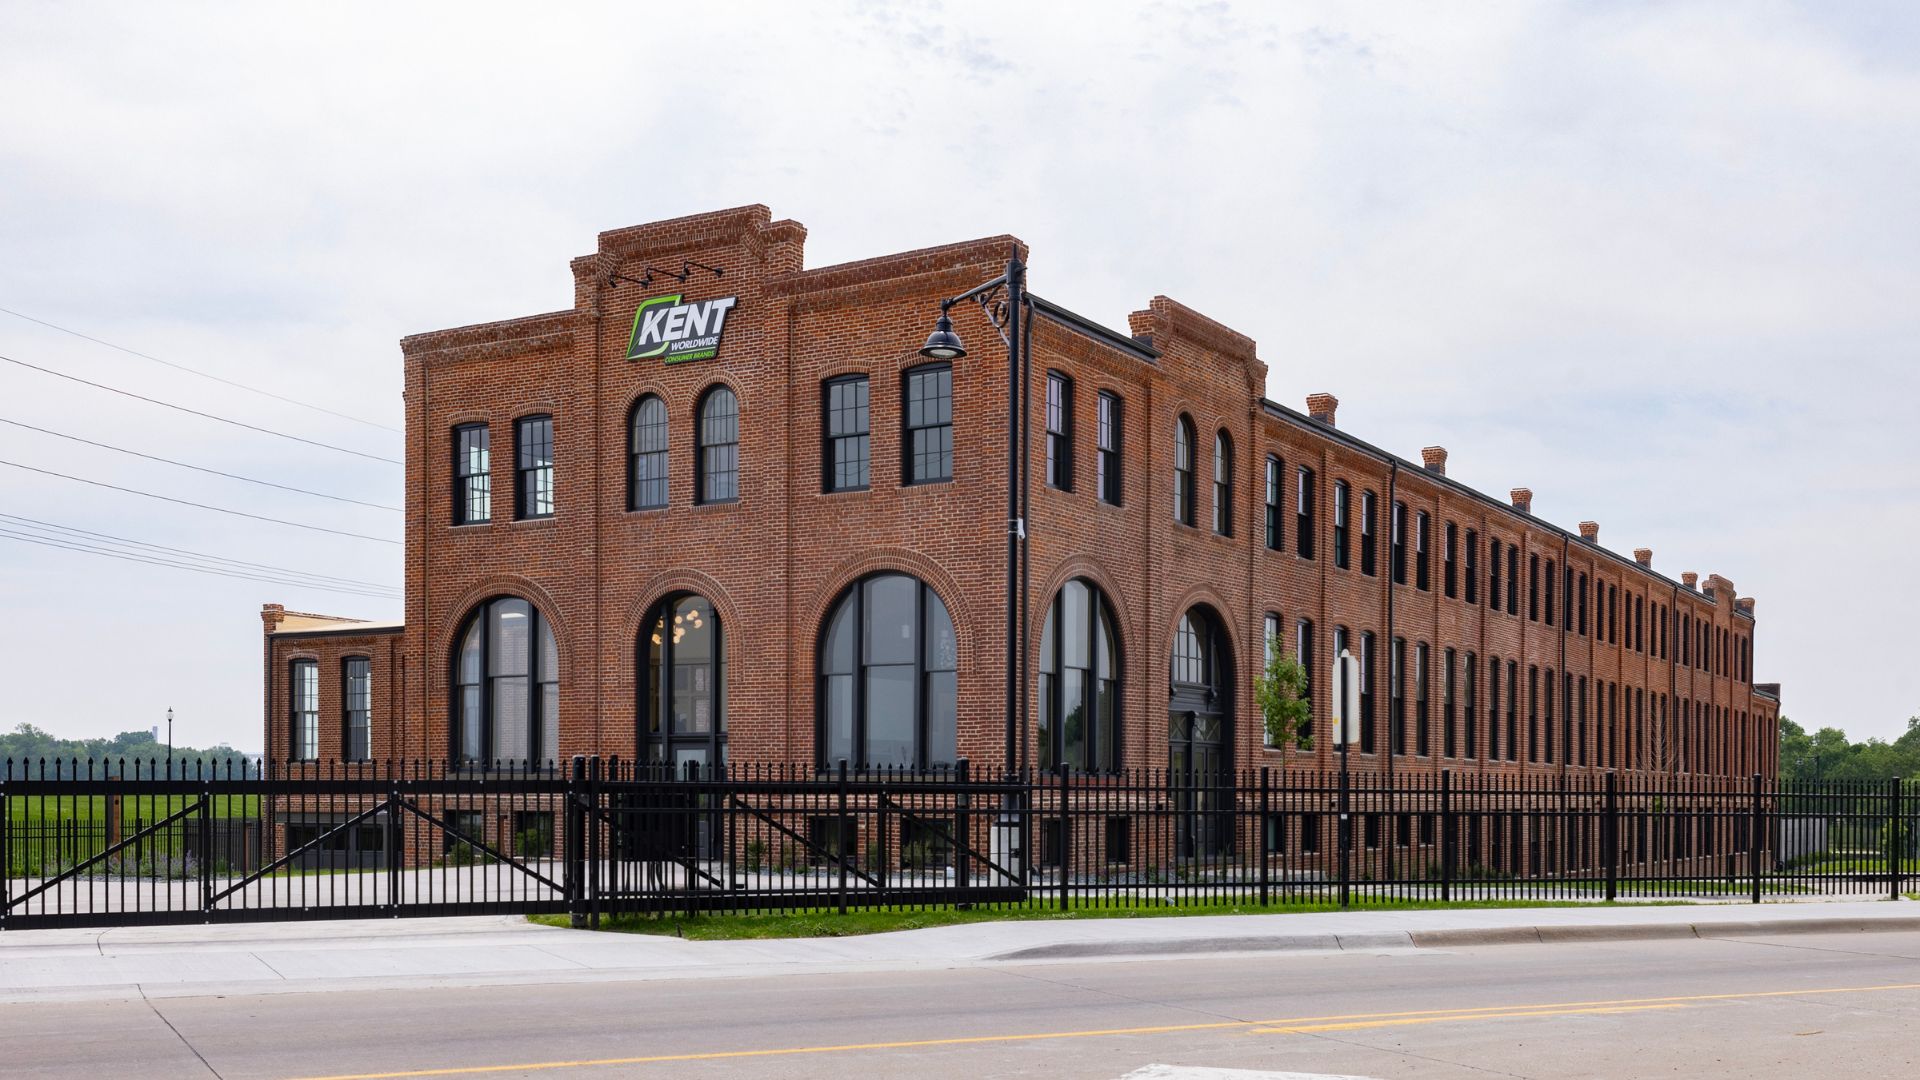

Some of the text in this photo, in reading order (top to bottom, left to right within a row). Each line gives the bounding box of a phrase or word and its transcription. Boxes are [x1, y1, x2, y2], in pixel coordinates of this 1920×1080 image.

[638, 297, 736, 346] KENT
[671, 336, 719, 351] WORLDWIDE
[665, 351, 715, 363] CONSUMER BRANDS
